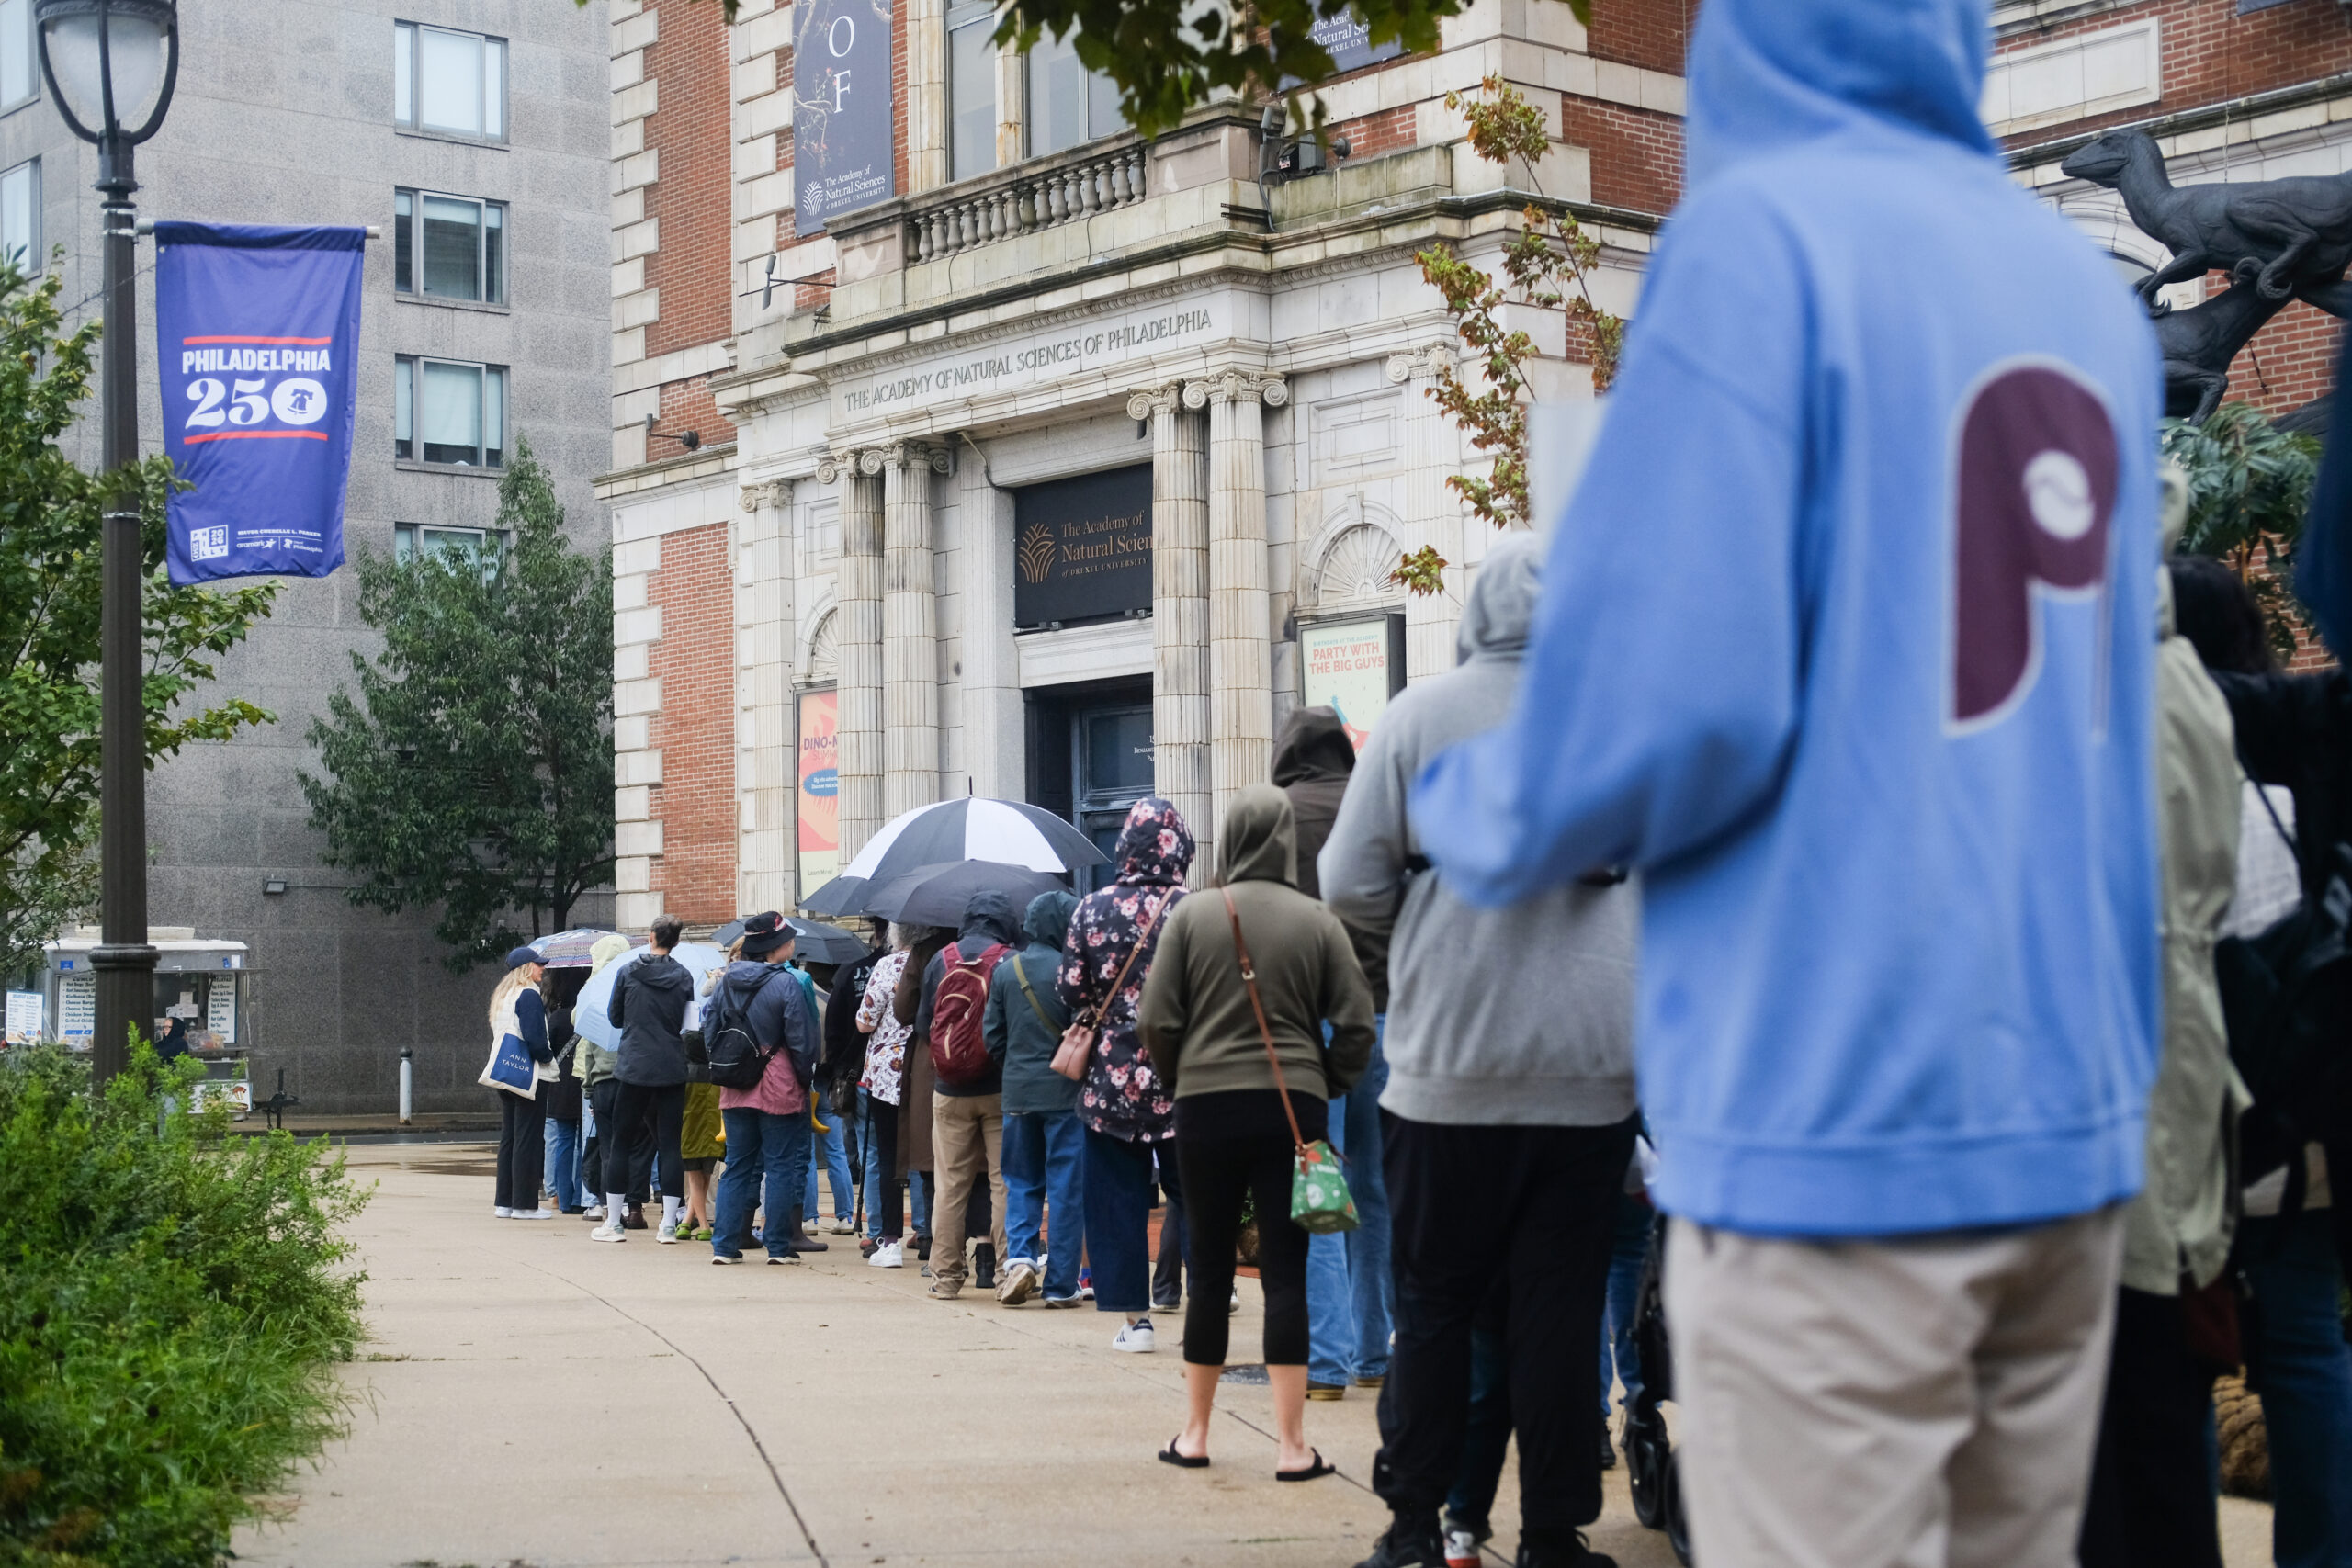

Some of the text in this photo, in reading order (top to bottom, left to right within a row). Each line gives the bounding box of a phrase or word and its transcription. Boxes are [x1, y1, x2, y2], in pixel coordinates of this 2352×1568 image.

[828, 15, 855, 58] O
[1313, 19, 1329, 33] The
[1313, 24, 1351, 46] Natural
[1325, 41, 1349, 55] REXEL
[833, 69, 851, 114] F
[825, 164, 871, 187] The Academy of
[825, 175, 886, 201] Natural Sciences
[831, 197, 851, 209] DREXEL
[853, 186, 886, 201] UNIVERSITY
[182, 347, 332, 374] PHILADELPHIA
[844, 309, 1212, 412] THE ACADEMY OF NATURAL SCIENCES OF PHILADELPHIA
[184, 377, 328, 430] 250
[1061, 510, 1145, 538] The Academy of
[236, 540, 265, 548] aramark
[1061, 532, 1154, 563] Natural Scien
[1070, 565, 1099, 576] DREXEL
[1102, 558, 1148, 570] UNIVERSITY
[1313, 641, 1380, 660] PARTY WITH
[1309, 655, 1385, 675] THE BIG GUYS
[502, 1059, 530, 1073] TAYLOR
[510, 1054, 526, 1064] ANN
